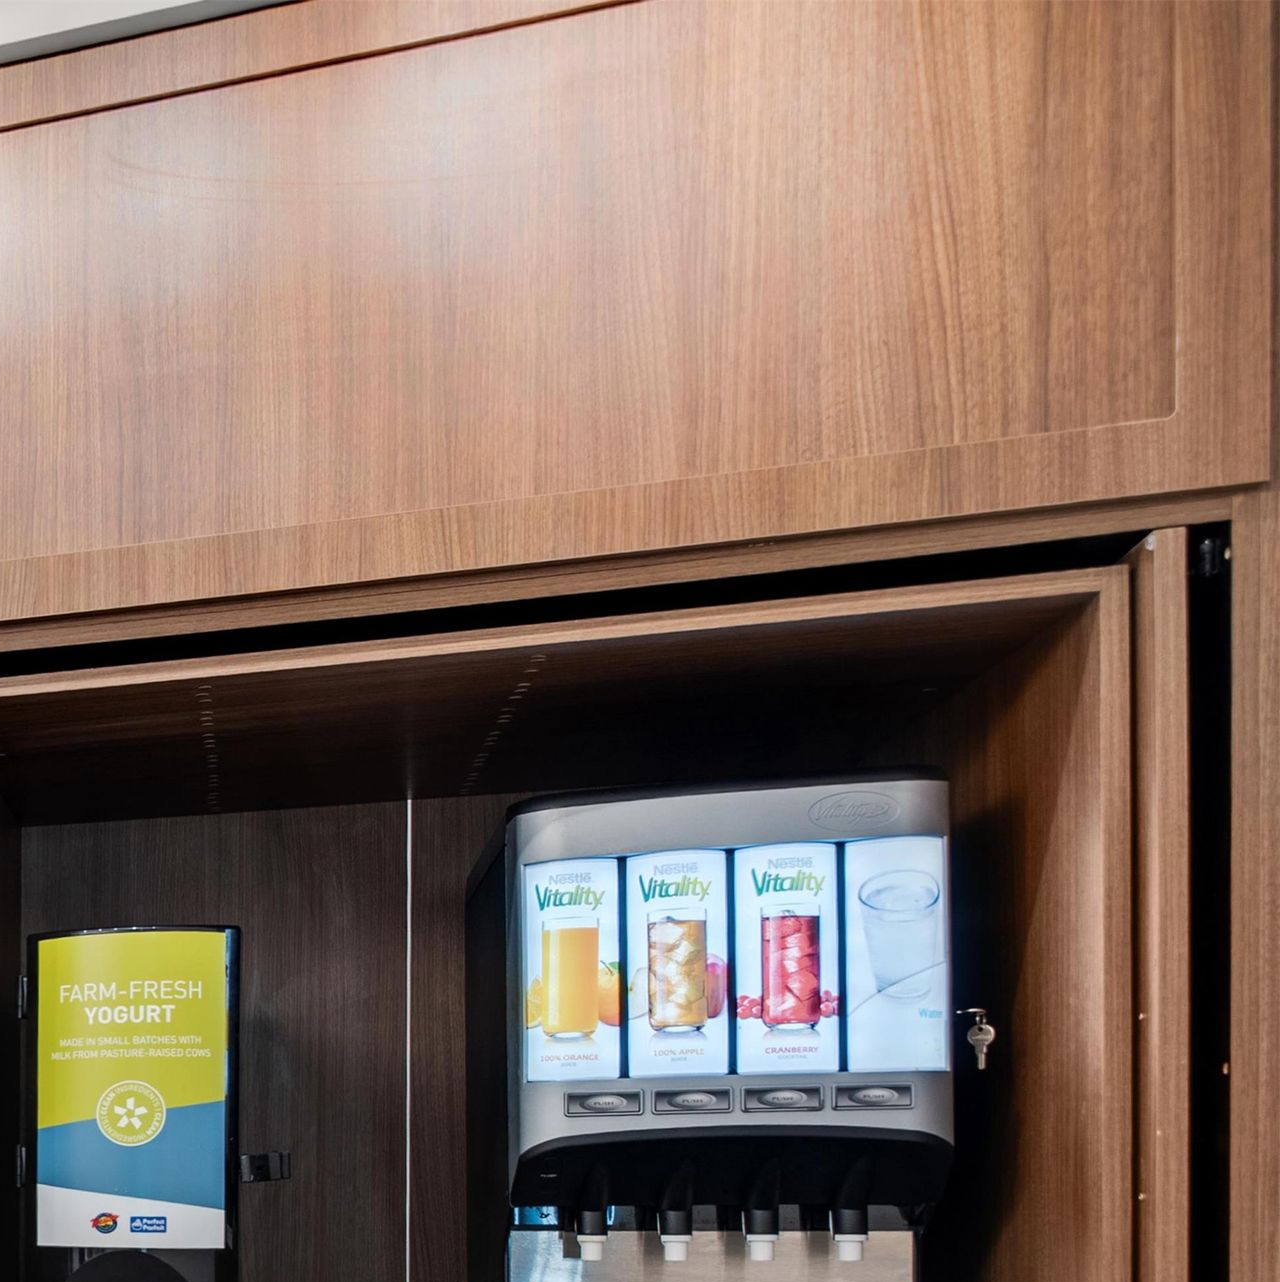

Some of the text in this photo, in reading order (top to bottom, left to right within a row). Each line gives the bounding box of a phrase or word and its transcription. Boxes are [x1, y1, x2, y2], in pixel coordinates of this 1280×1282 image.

[639, 874, 711, 902] Vitality
[752, 869, 825, 897] Vitality
[535, 884, 605, 911] Vitality
[60, 980, 202, 1003] FARM-FRESH
[85, 1005, 175, 1024] YOGURT
[919, 1008, 943, 1018] Water
[60, 1039, 83, 1047] MADE
[97, 1037, 130, 1045] SMALL
[133, 1036, 176, 1044] BATCHES
[51, 1048, 211, 1060] MILK FROM PASTURE-RAISED COWS
[652, 1049, 677, 1057] 100%
[765, 1046, 818, 1055] CRANBERRY
